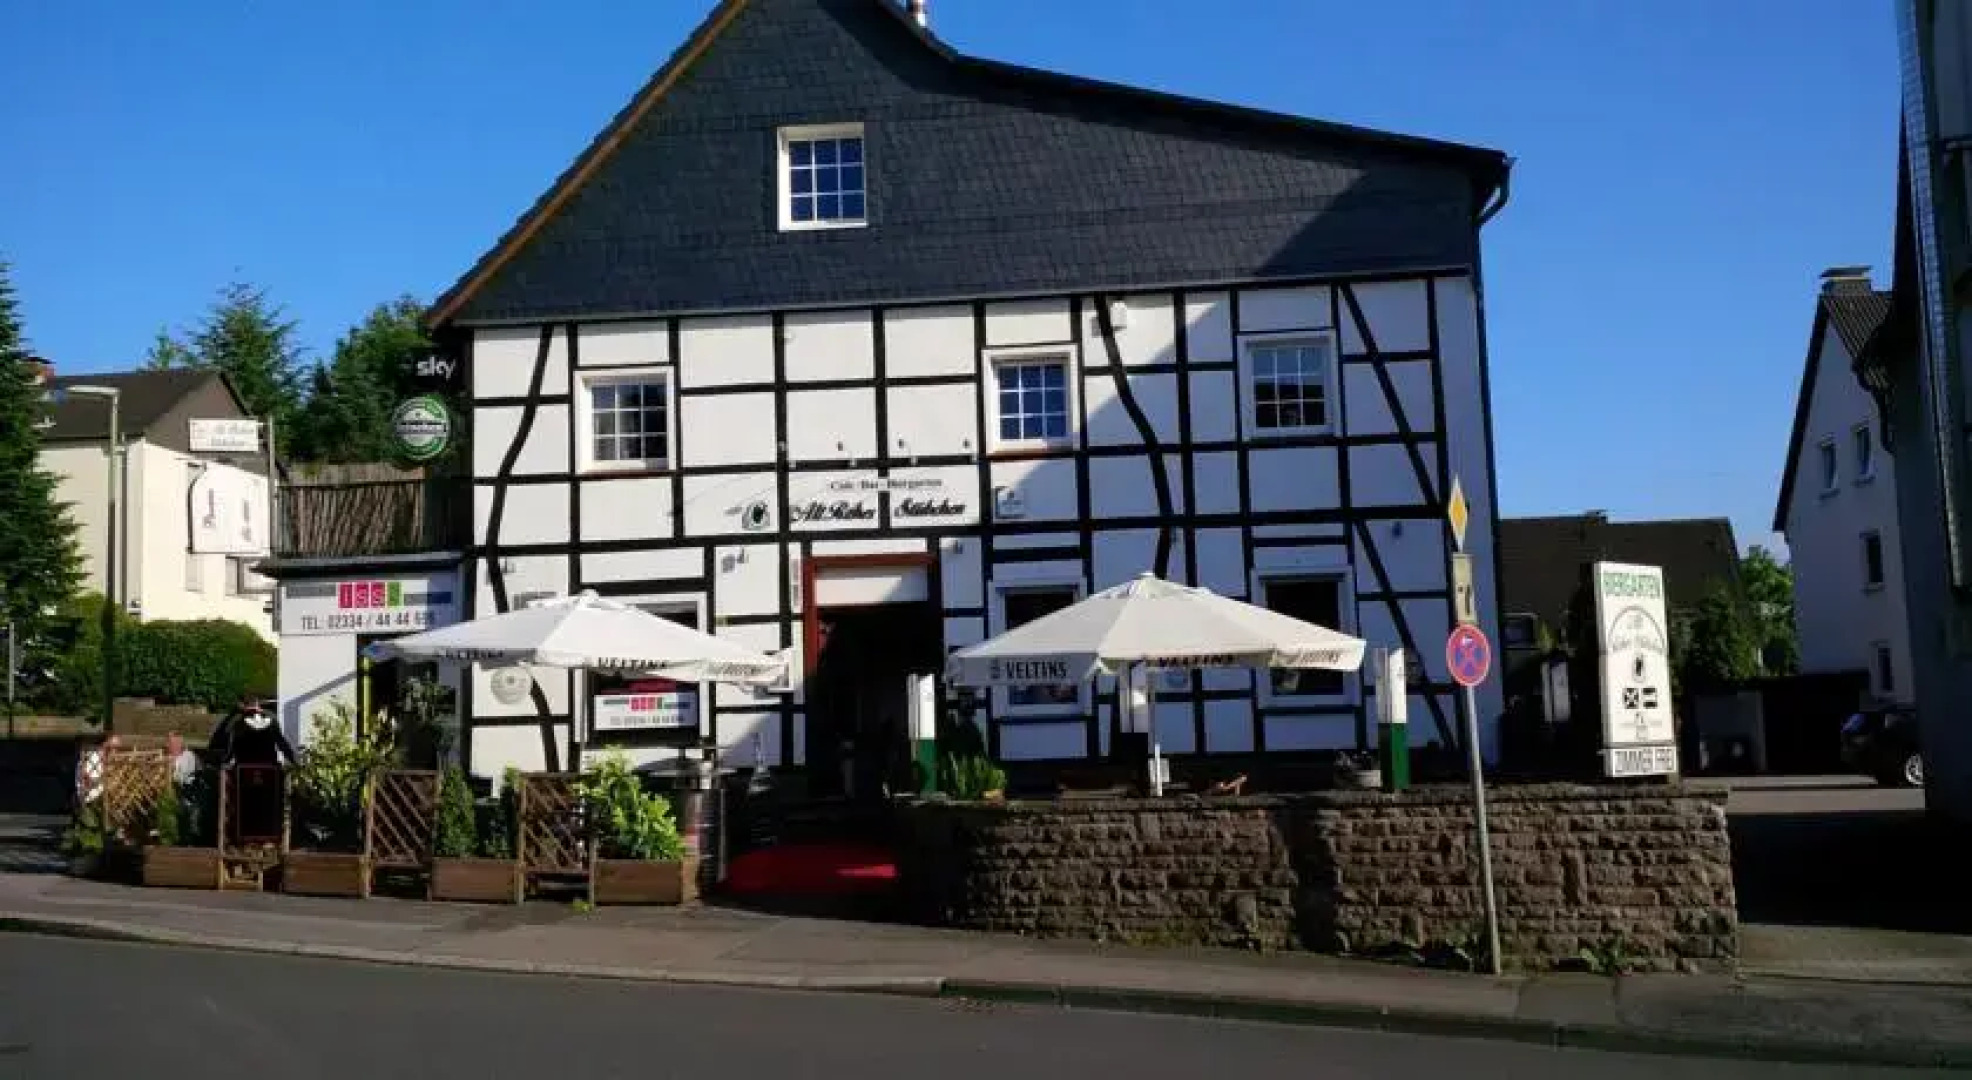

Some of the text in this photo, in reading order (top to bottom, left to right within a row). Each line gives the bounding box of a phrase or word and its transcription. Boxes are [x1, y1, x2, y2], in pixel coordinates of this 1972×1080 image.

[417, 356, 456, 380] sky
[1602, 571, 1661, 599] BIERGARTEN
[1006, 660, 1067, 680] VELTINS
